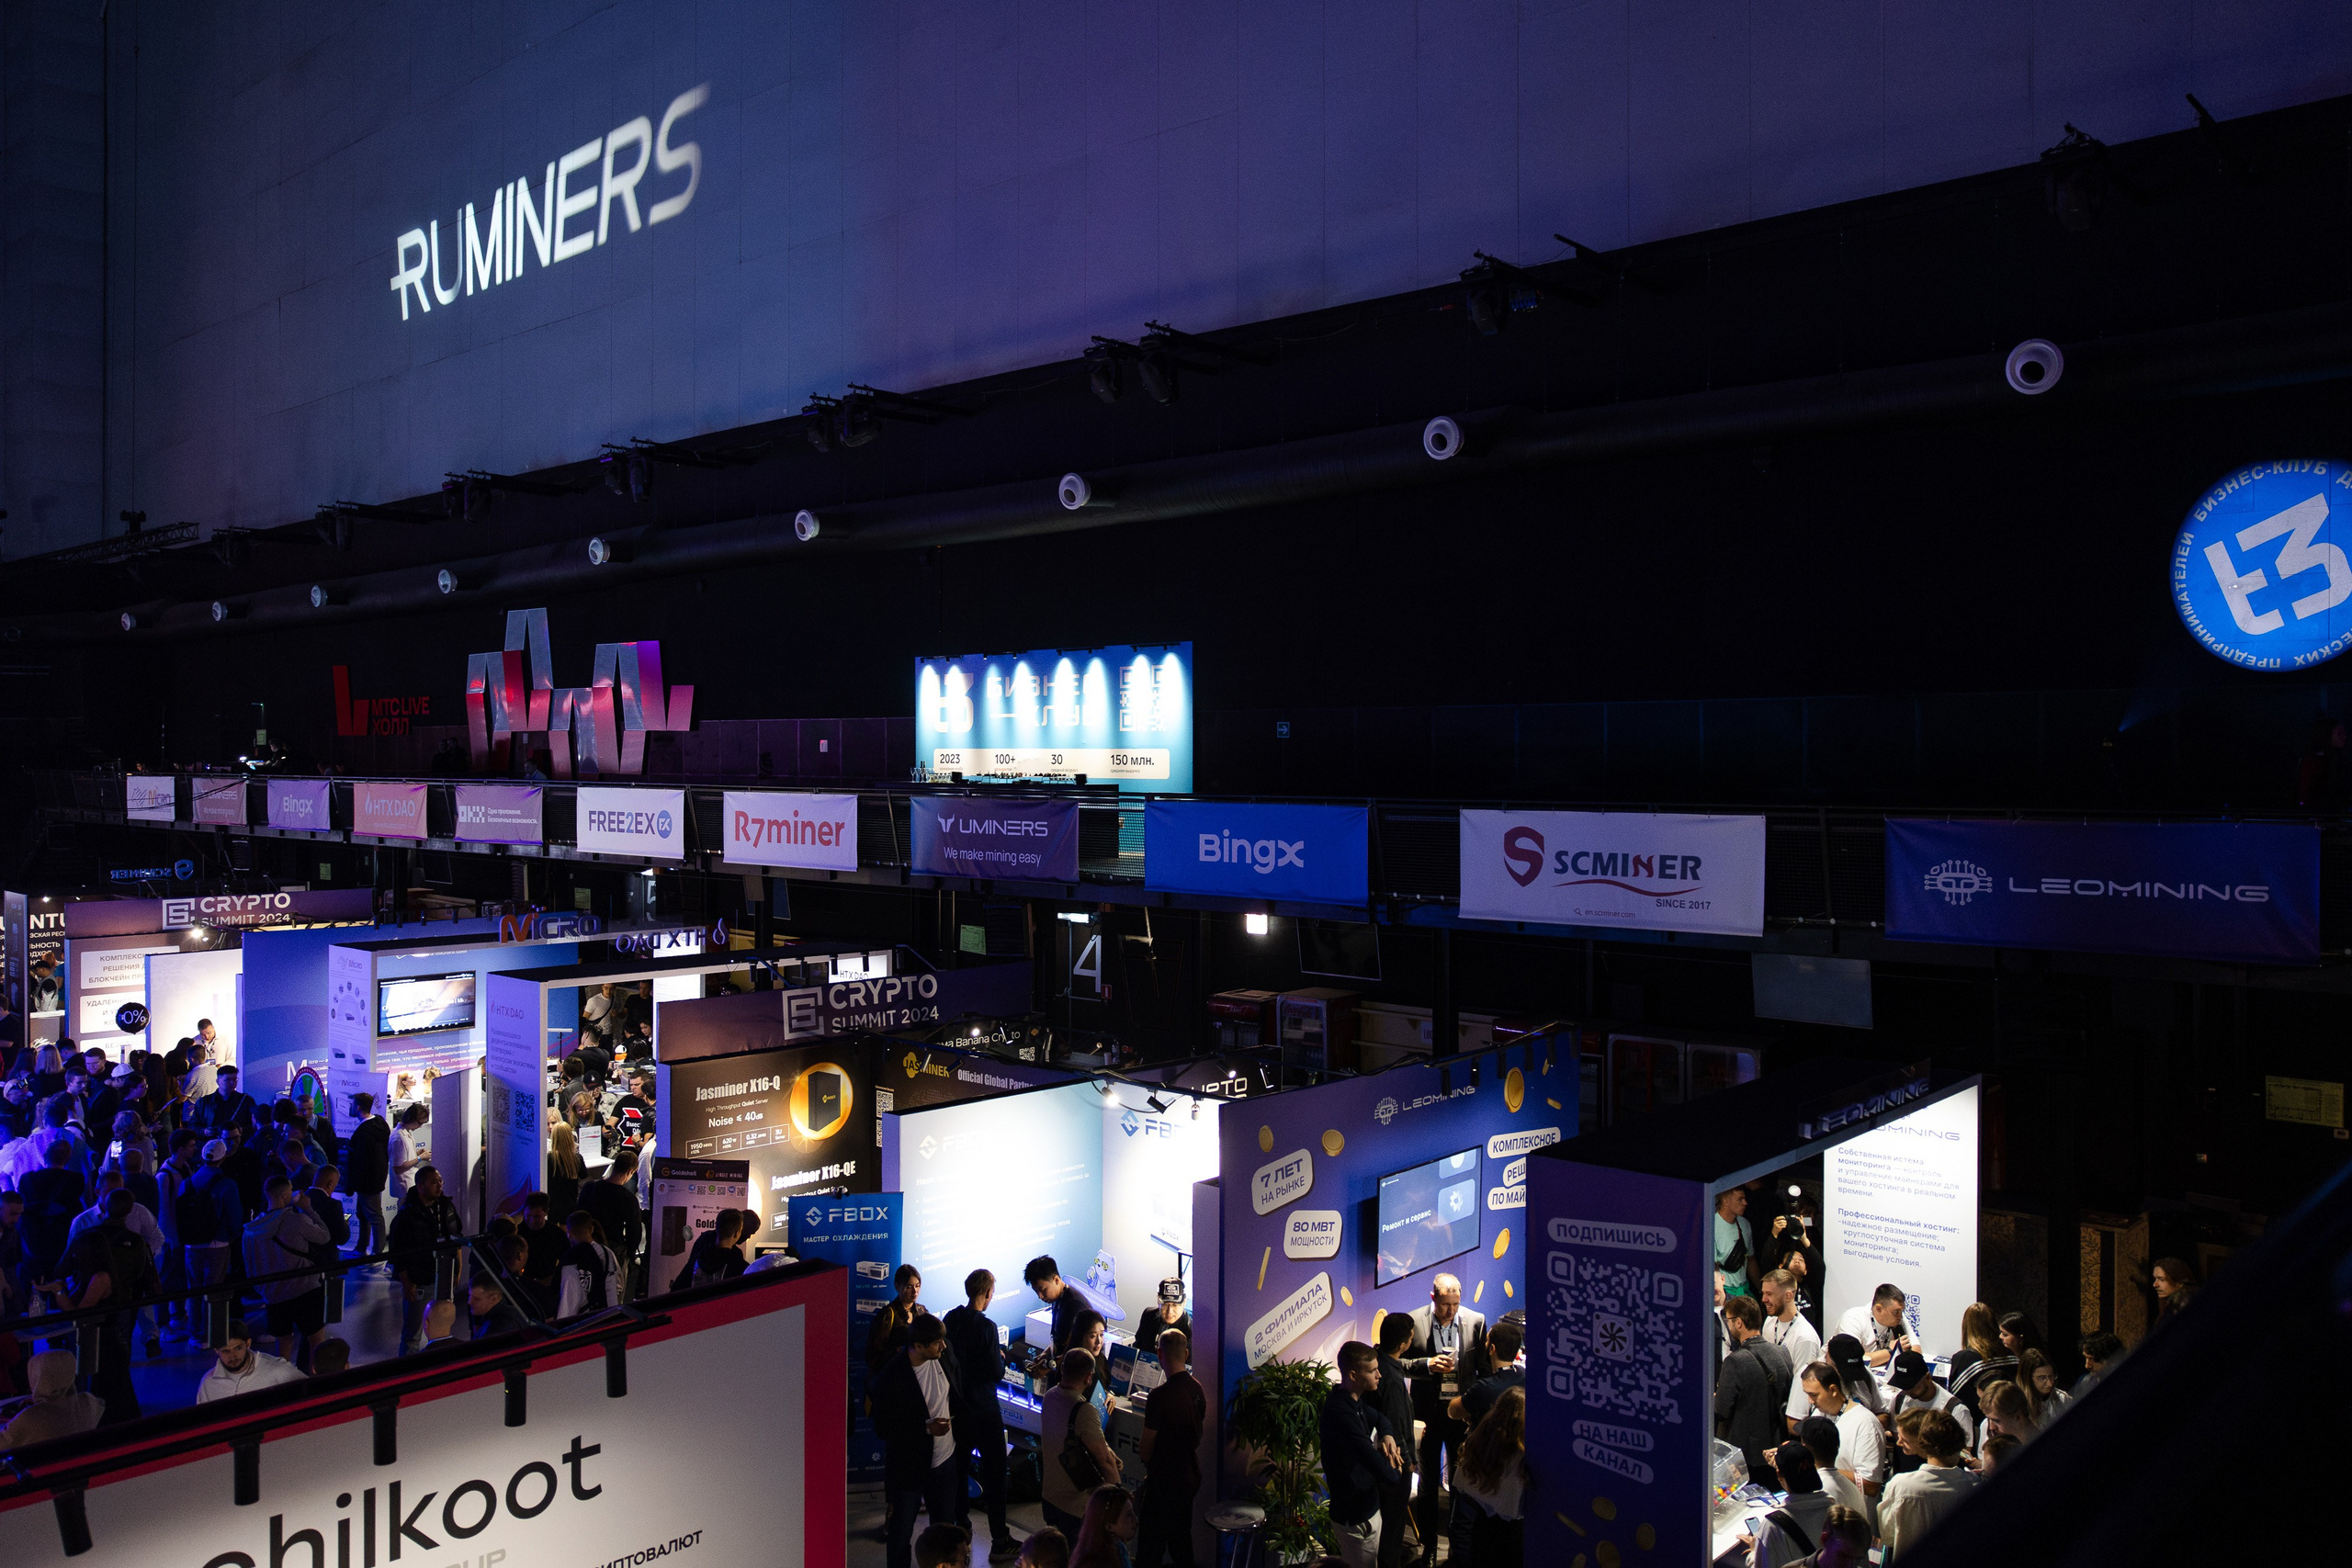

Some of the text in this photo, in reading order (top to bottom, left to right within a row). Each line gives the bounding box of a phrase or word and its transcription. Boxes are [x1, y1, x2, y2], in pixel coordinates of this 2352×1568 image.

[390, 82, 710, 321] RUMINERS
[2193, 459, 2328, 523] БИЗНЕС-КЛУБ
[2175, 532, 2281, 669] ПРЕДПРИНИМАТЕЛЕЙ
[939, 753, 961, 764] 2023
[994, 753, 1016, 765] 100+
[1050, 753, 1063, 765] 30
[1110, 753, 1128, 765] 150
[373, 799, 414, 818] HTX DAO
[588, 810, 656, 835] FREE2EX
[735, 810, 845, 849] R7miner
[959, 818, 1048, 837] UMINERS
[944, 847, 1042, 867] We make mining easy
[1554, 850, 1702, 881] SCMINER
[2009, 877, 2269, 903] LEOMINING
[199, 892, 291, 913] CRYPTO
[1656, 898, 1712, 910] SINCE 2017
[259, 912, 291, 924] 2024
[103, 964, 140, 972] РЕШЕНИЯ
[1073, 934, 1102, 993] 4
[89, 974, 130, 984] БЛОКЧЕЙН
[829, 974, 938, 1010] CRYPTO
[901, 1005, 940, 1025] 2024
[956, 1034, 989, 1047] Banana
[695, 1075, 781, 1101] Jasminer X16-Q
[957, 1068, 983, 1084] Official
[984, 1073, 1008, 1089] Global
[717, 1101, 741, 1112] Throughput
[741, 1099, 755, 1108] Quiet
[755, 1097, 768, 1105] Server
[708, 1115, 734, 1128] Noise
[1492, 1132, 1556, 1154] КОМПЛЕКСНОЕ
[1838, 1146, 1892, 1161] Собственная
[671, 1168, 697, 1177] Goldshell
[771, 1160, 856, 1190] Jasminer X16-QE
[1261, 1157, 1304, 1189] 7 ЛЕТ
[1838, 1157, 1942, 1179] мониторинга контроль
[1845, 1168, 1893, 1181] управление
[1261, 1175, 1306, 1205] НА РЫНКЕ
[1491, 1192, 1504, 1205] ПО
[1838, 1177, 1867, 1187] вашего
[1869, 1181, 1905, 1193] хостинга
[1914, 1188, 1956, 1201] реальном
[1838, 1186, 1875, 1198] времени.
[829, 1206, 889, 1223] FBOX
[1382, 1209, 1432, 1234] Ремонт и сервис
[1838, 1208, 1960, 1235] Профессиональный хостинг:
[1293, 1221, 1336, 1233] 80 МВТ
[1556, 1223, 1667, 1247] ПОДПИШИСЬ
[1884, 1226, 1939, 1242] размещение;
[803, 1232, 889, 1243] МАСТЕР ОХЛАЖДЕНИЯ
[1290, 1235, 1335, 1248] МОЩНОСТИ
[1843, 1229, 1946, 1252] круглосуточная система
[1844, 1238, 1899, 1255] мониторинга;
[1843, 1248, 1922, 1268] выгодные условия.
[1254, 1282, 1324, 1345] 2 ФИЛИАЛА
[1252, 1331, 1287, 1360] МОСКВА
[1295, 1293, 1329, 1328] ИРКУТСК
[1579, 1423, 1647, 1449] НА НАШ
[1583, 1445, 1643, 1479] КАНАЛ
